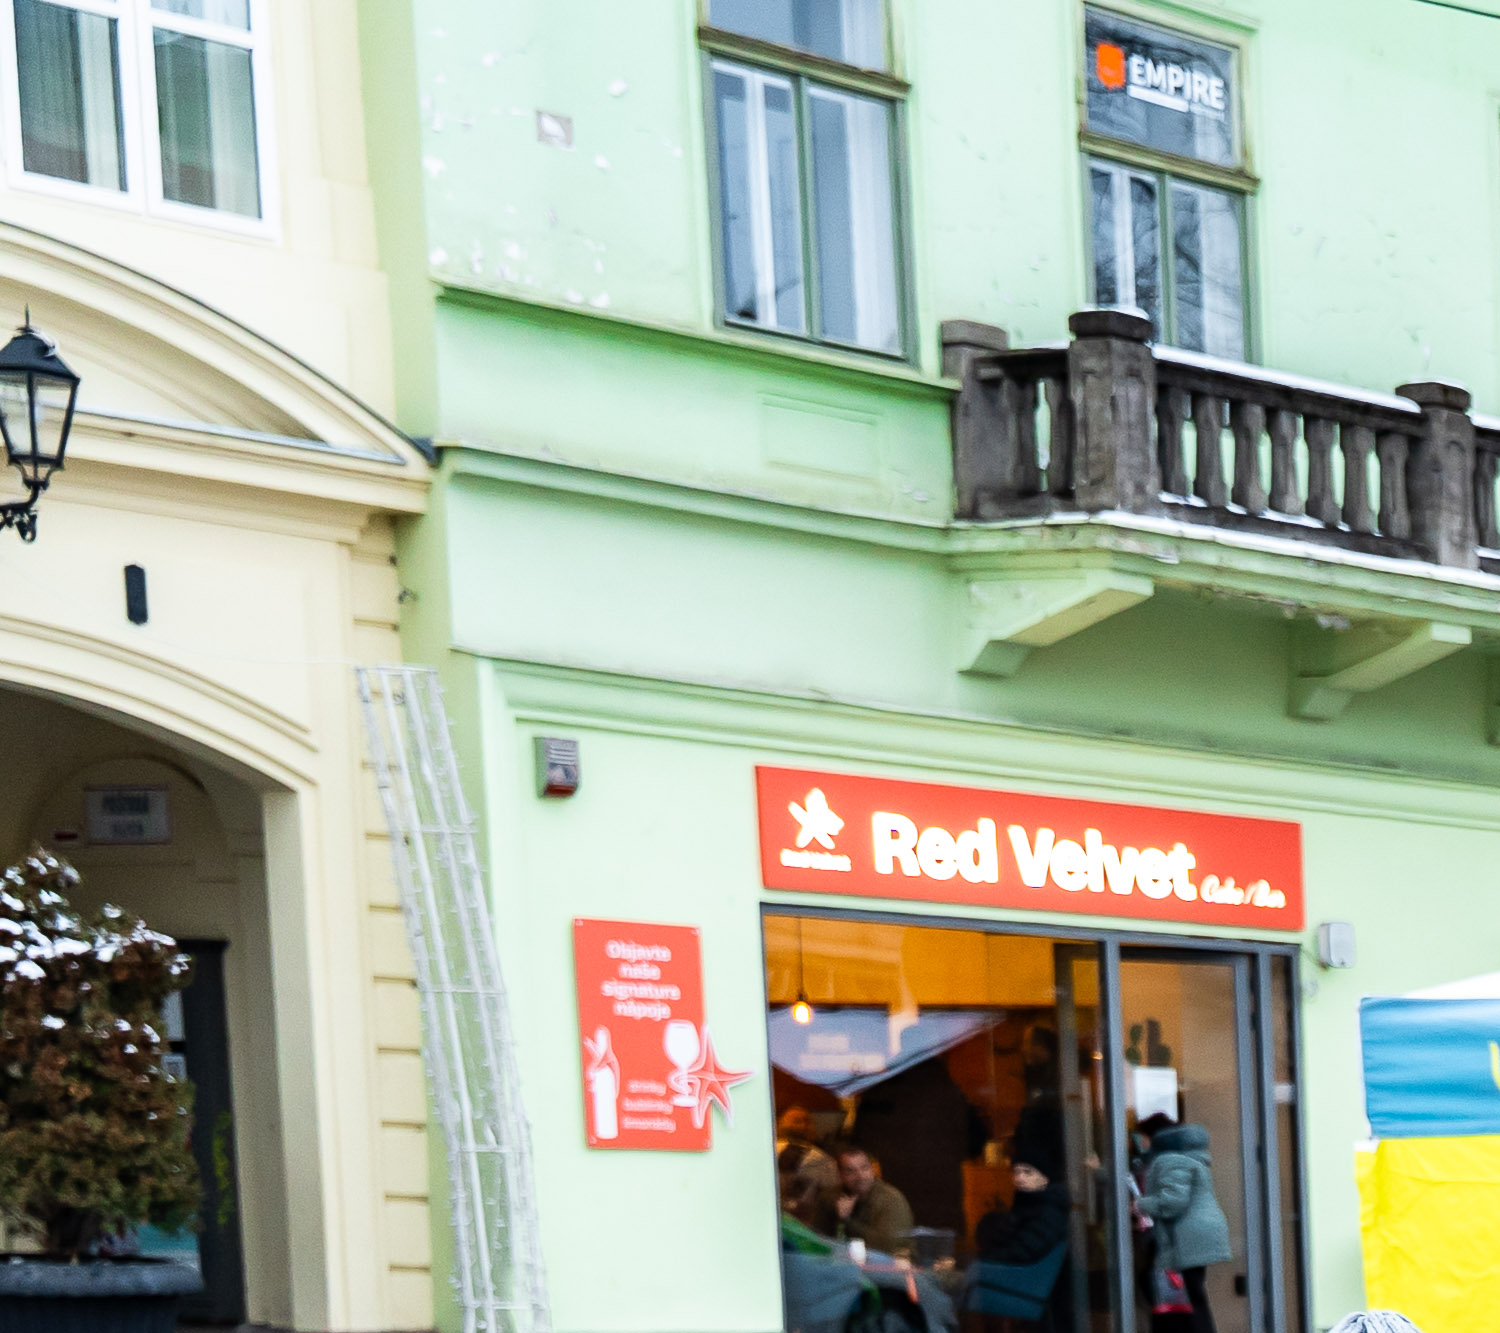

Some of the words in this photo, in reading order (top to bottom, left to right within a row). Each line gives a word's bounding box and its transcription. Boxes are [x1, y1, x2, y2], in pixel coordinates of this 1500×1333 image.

[1128, 53, 1225, 111] EMPIRE
[871, 811, 999, 884] Red
[1007, 823, 1197, 901] Velvet
[602, 979, 681, 1001] signature
